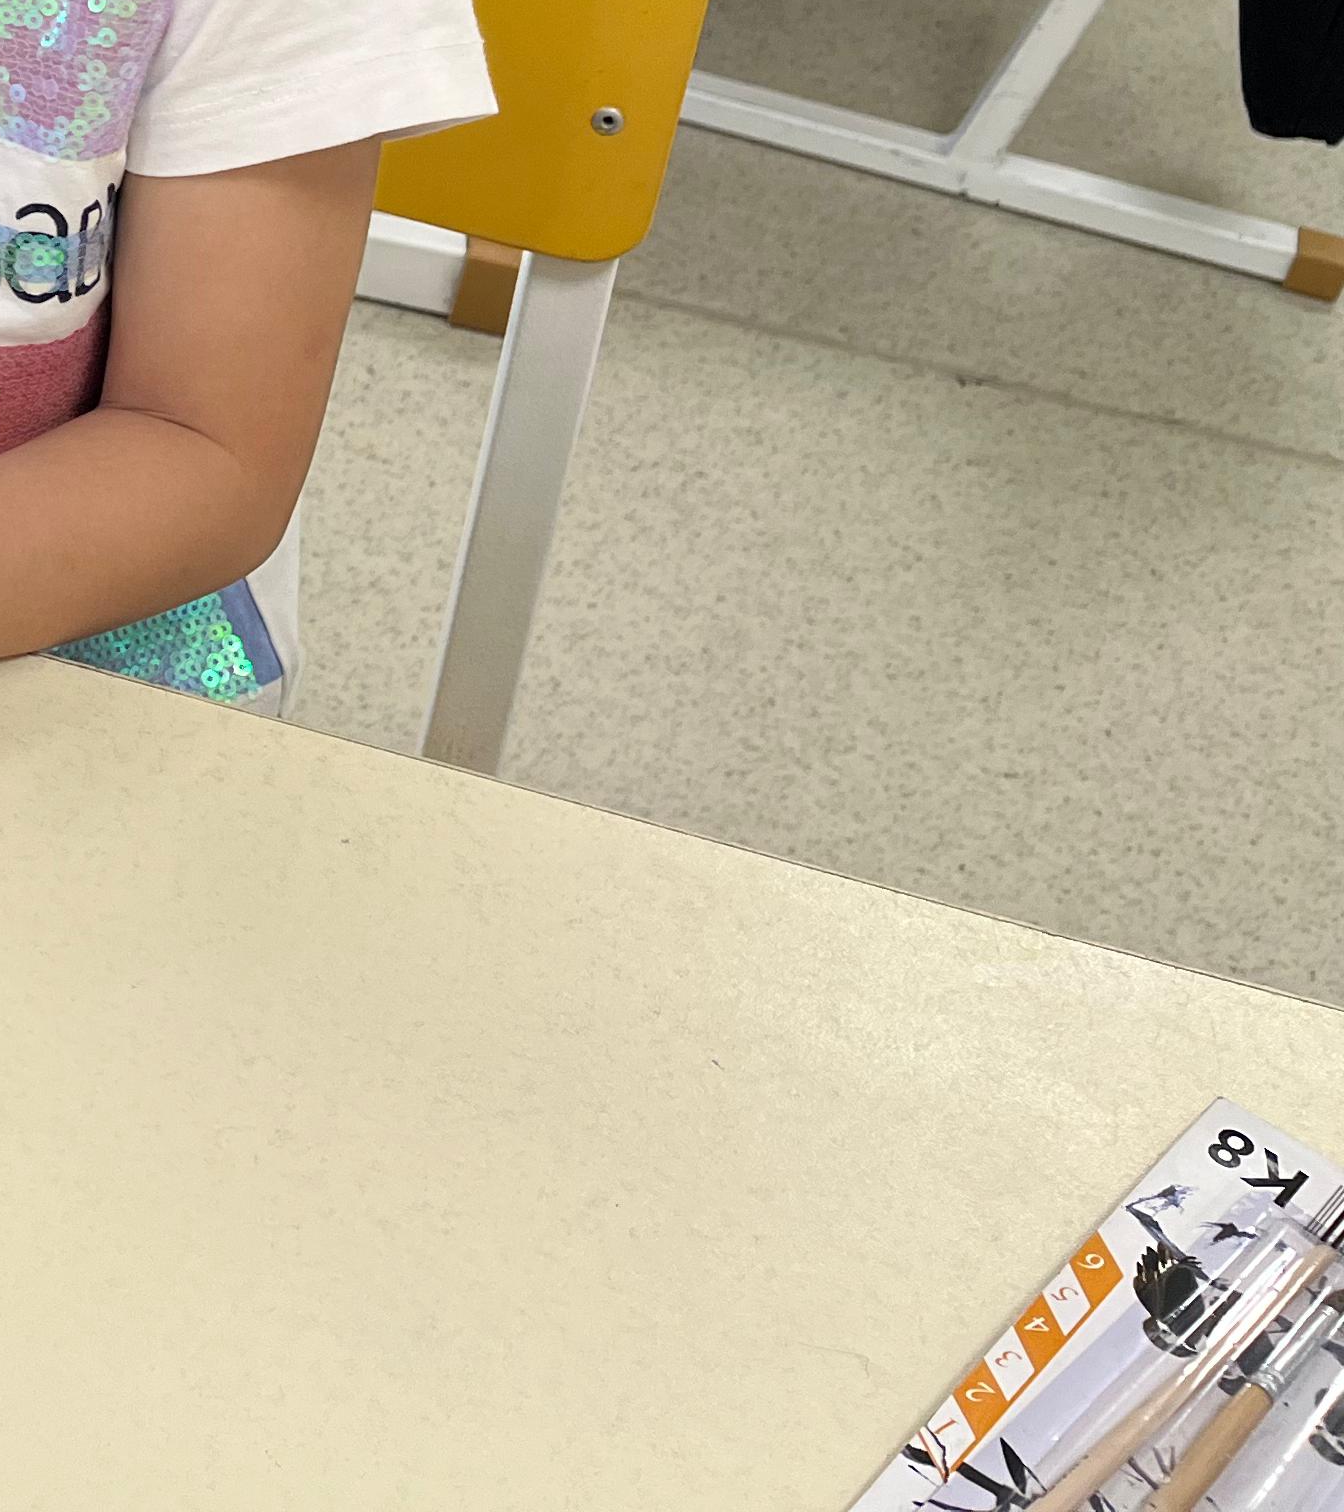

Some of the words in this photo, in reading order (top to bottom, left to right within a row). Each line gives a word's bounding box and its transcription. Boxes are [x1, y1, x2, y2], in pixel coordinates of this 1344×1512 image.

[1076, 1253, 1105, 1270] 6
[1050, 1286, 1079, 1301] 5
[1023, 1316, 1050, 1332] 4
[994, 1350, 1023, 1368] 3
[965, 1381, 996, 1402] 2
[934, 1417, 959, 1435] 1
